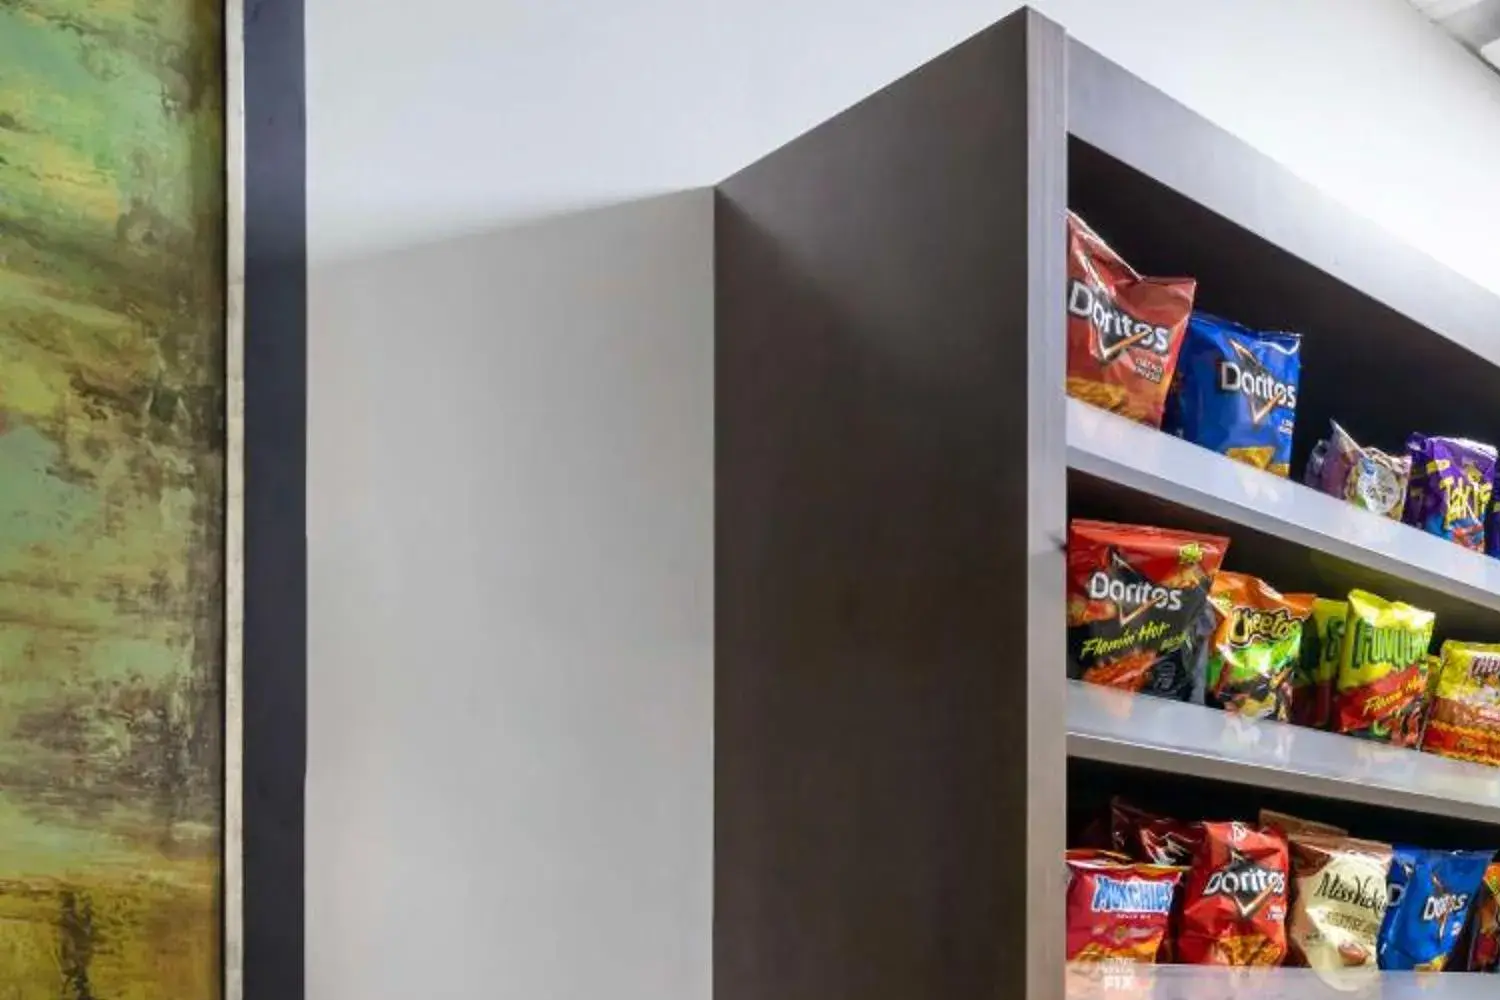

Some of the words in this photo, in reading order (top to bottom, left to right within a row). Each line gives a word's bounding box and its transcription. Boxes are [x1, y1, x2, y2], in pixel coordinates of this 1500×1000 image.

[1069, 279, 1169, 353] Doritos
[1220, 360, 1298, 410] Doritos
[1089, 571, 1183, 611] Doritos
[1228, 605, 1302, 646] Cheetos
[1202, 867, 1285, 897] Doritos
[1352, 874, 1387, 920] Vicki
